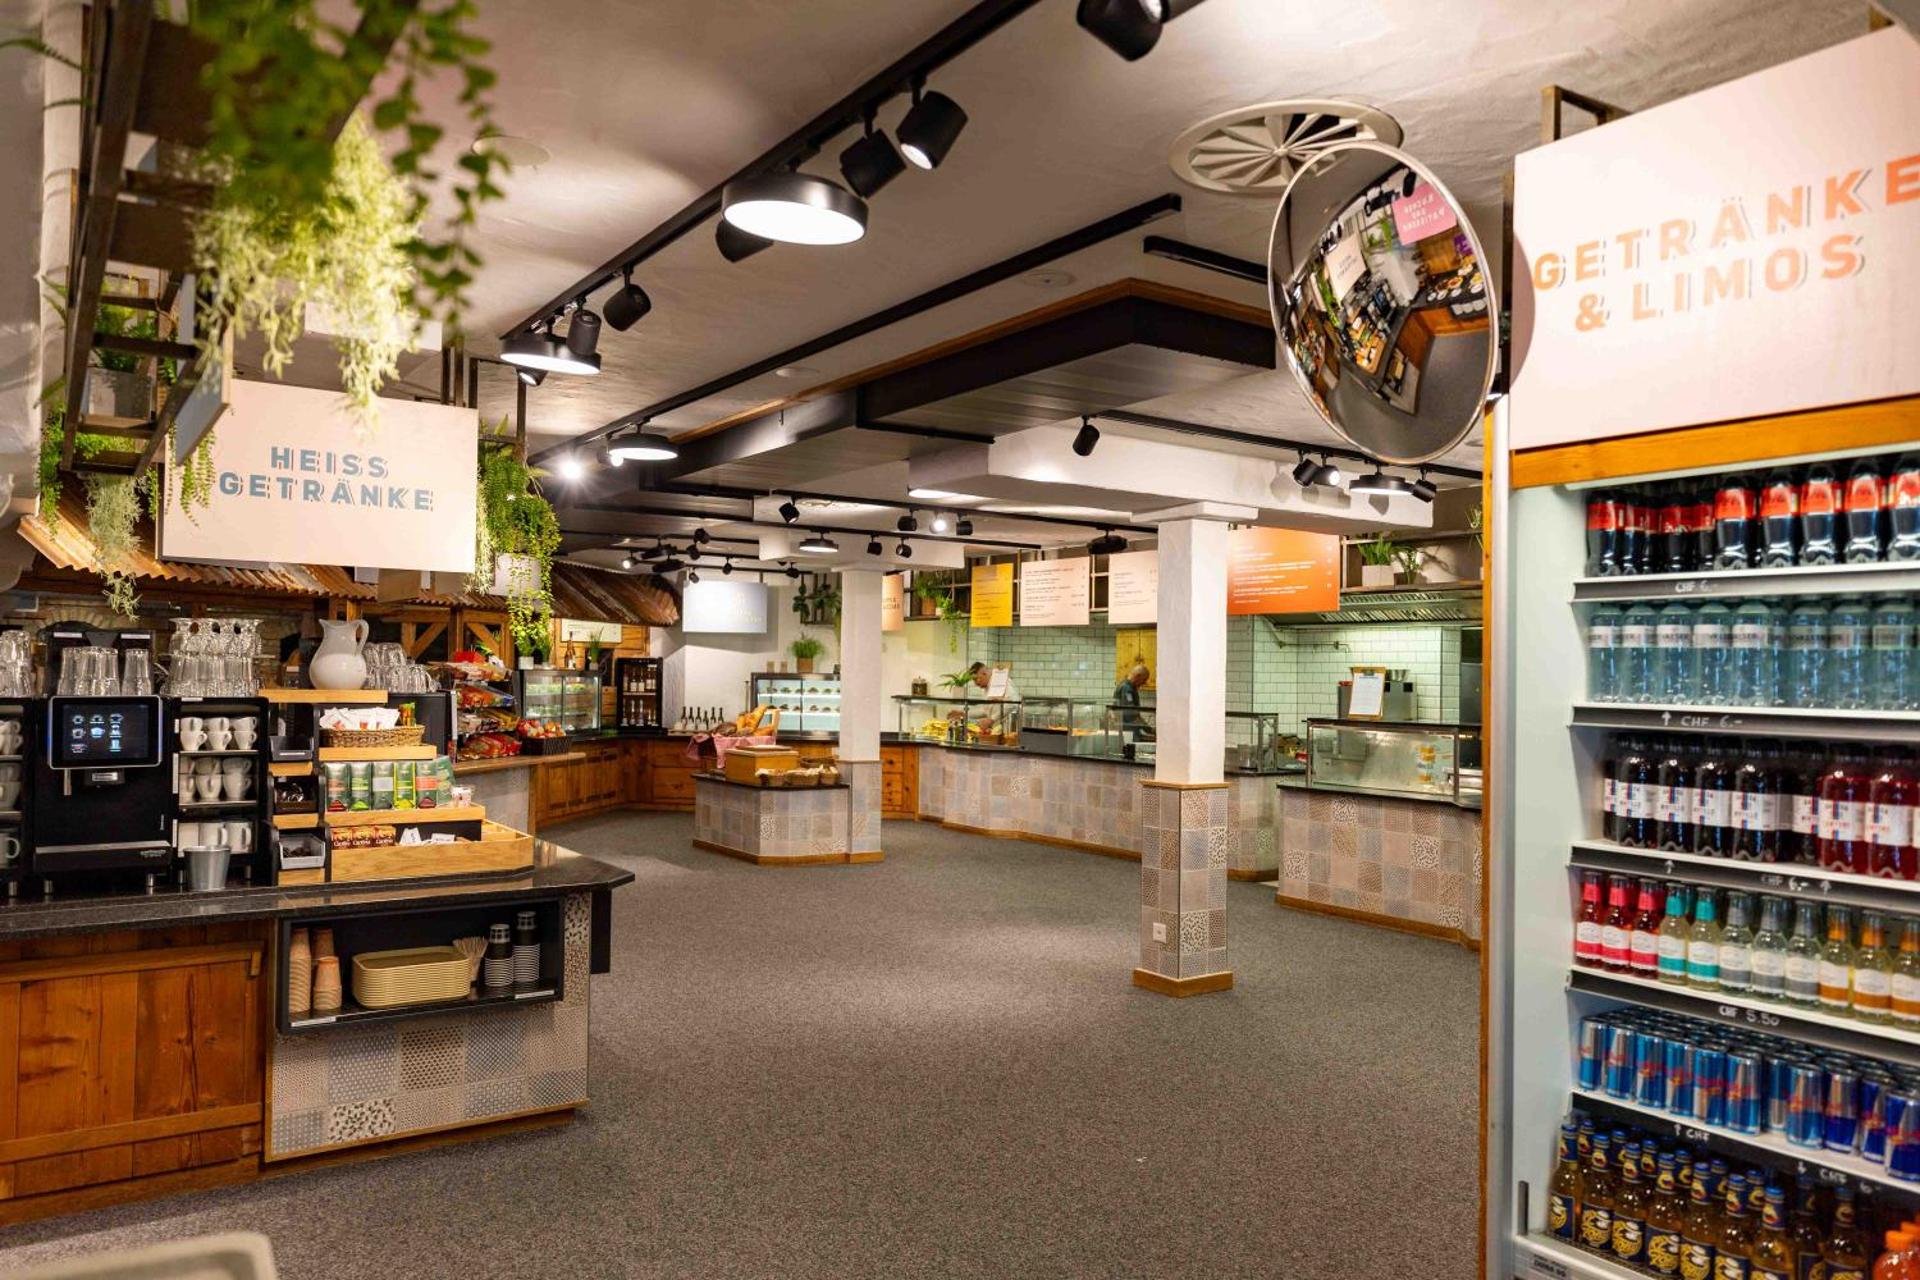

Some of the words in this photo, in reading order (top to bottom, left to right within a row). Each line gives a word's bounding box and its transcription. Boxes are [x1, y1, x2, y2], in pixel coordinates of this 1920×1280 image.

[1534, 153, 1920, 291] GETRÄNKE
[1575, 294, 1611, 333] &
[1632, 233, 1866, 321] LIMOS
[270, 446, 389, 479] HEISS
[218, 471, 434, 512] GETRÄNKE
[1680, 715, 1711, 728] CHF
